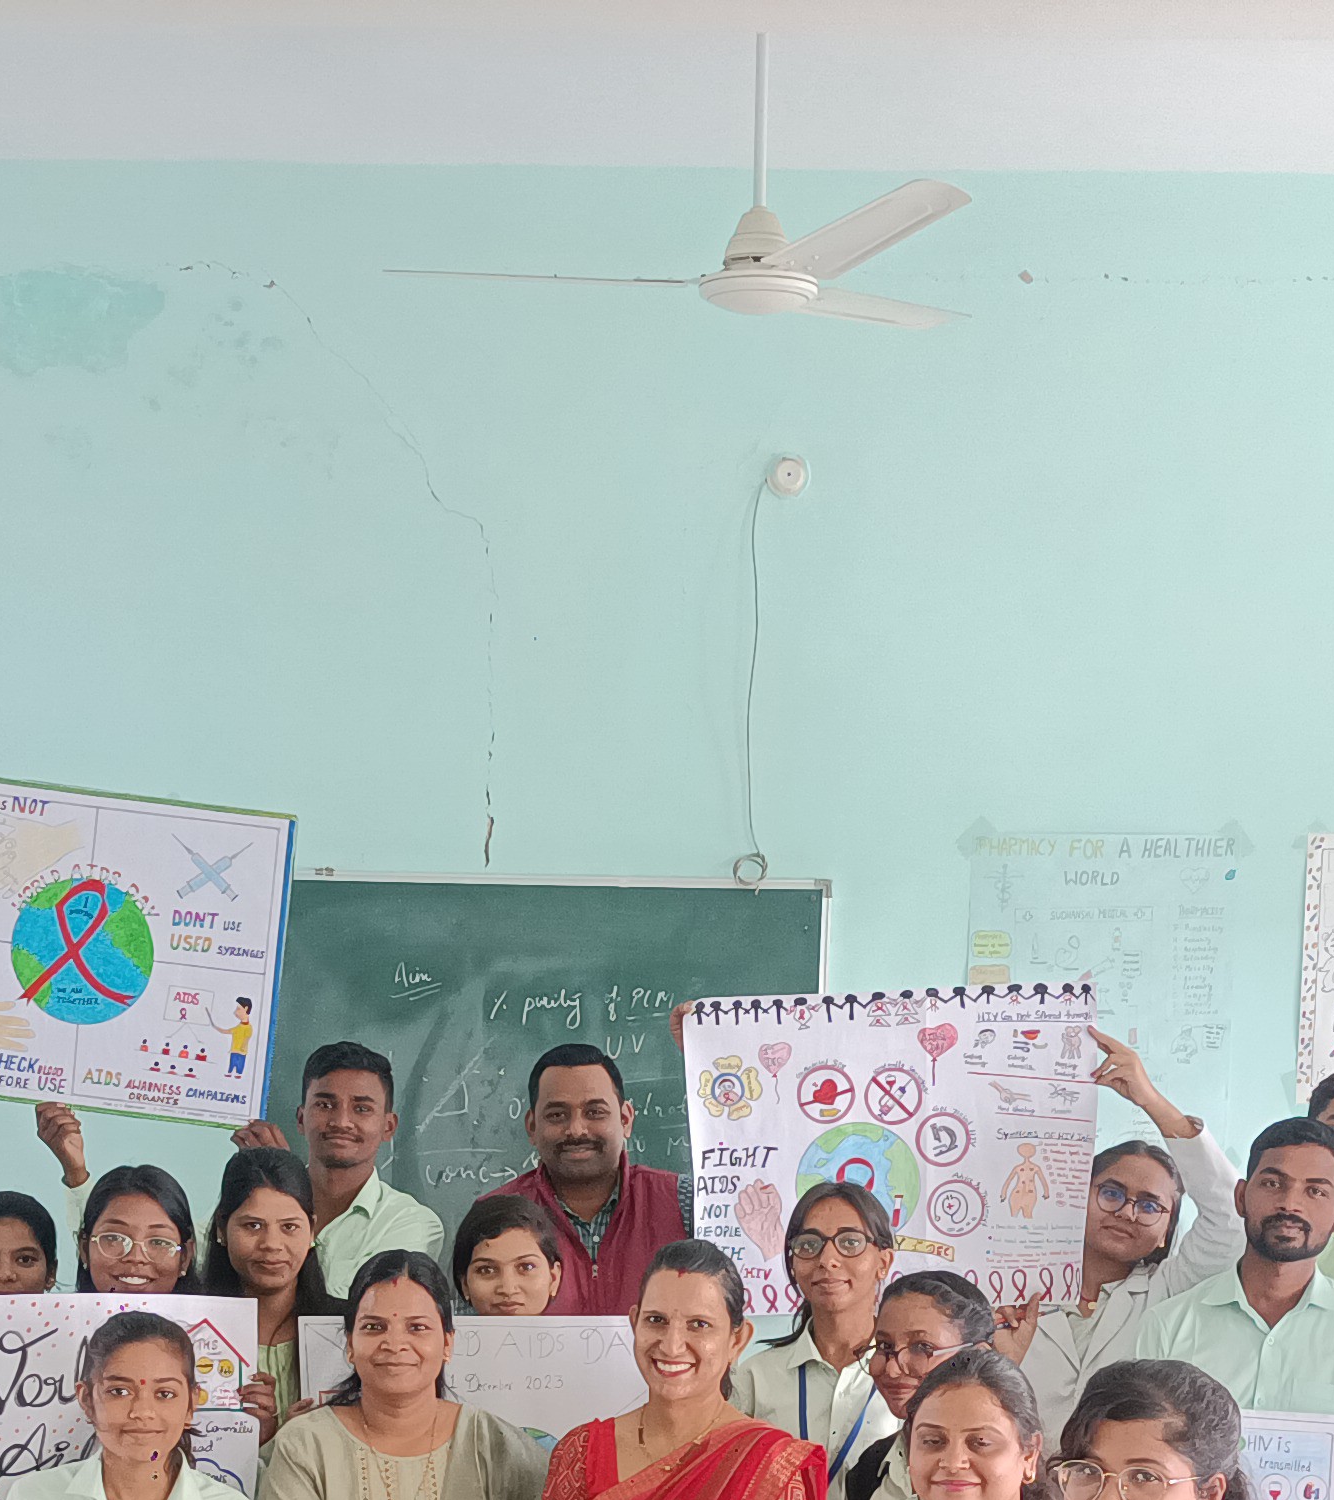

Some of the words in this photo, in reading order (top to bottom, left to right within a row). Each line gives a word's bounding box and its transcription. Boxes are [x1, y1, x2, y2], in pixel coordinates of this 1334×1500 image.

[12, 795, 51, 817] NOT
[1068, 839, 1105, 859] FOR
[1118, 838, 1132, 858] A
[1141, 837, 1236, 858] HEALTHIER
[1064, 869, 1120, 887] WORLD
[172, 909, 219, 931] DONT
[223, 920, 243, 932] USE
[170, 934, 213, 955] USED
[394, 961, 432, 987] Aim
[173, 991, 200, 1006] AIDS
[37, 1076, 67, 1095] USE
[82, 1068, 122, 1088] AIDS
[701, 1145, 779, 1169] FIGHT
[697, 1175, 741, 1197] AIDS
[700, 1204, 731, 1221] NOT
[697, 1225, 742, 1238] PEOPLE
[495, 1329, 565, 1360] AIDS
[526, 1374, 564, 1390] 2023
[1247, 1434, 1272, 1452] HIV
[1276, 1436, 1291, 1453] is
